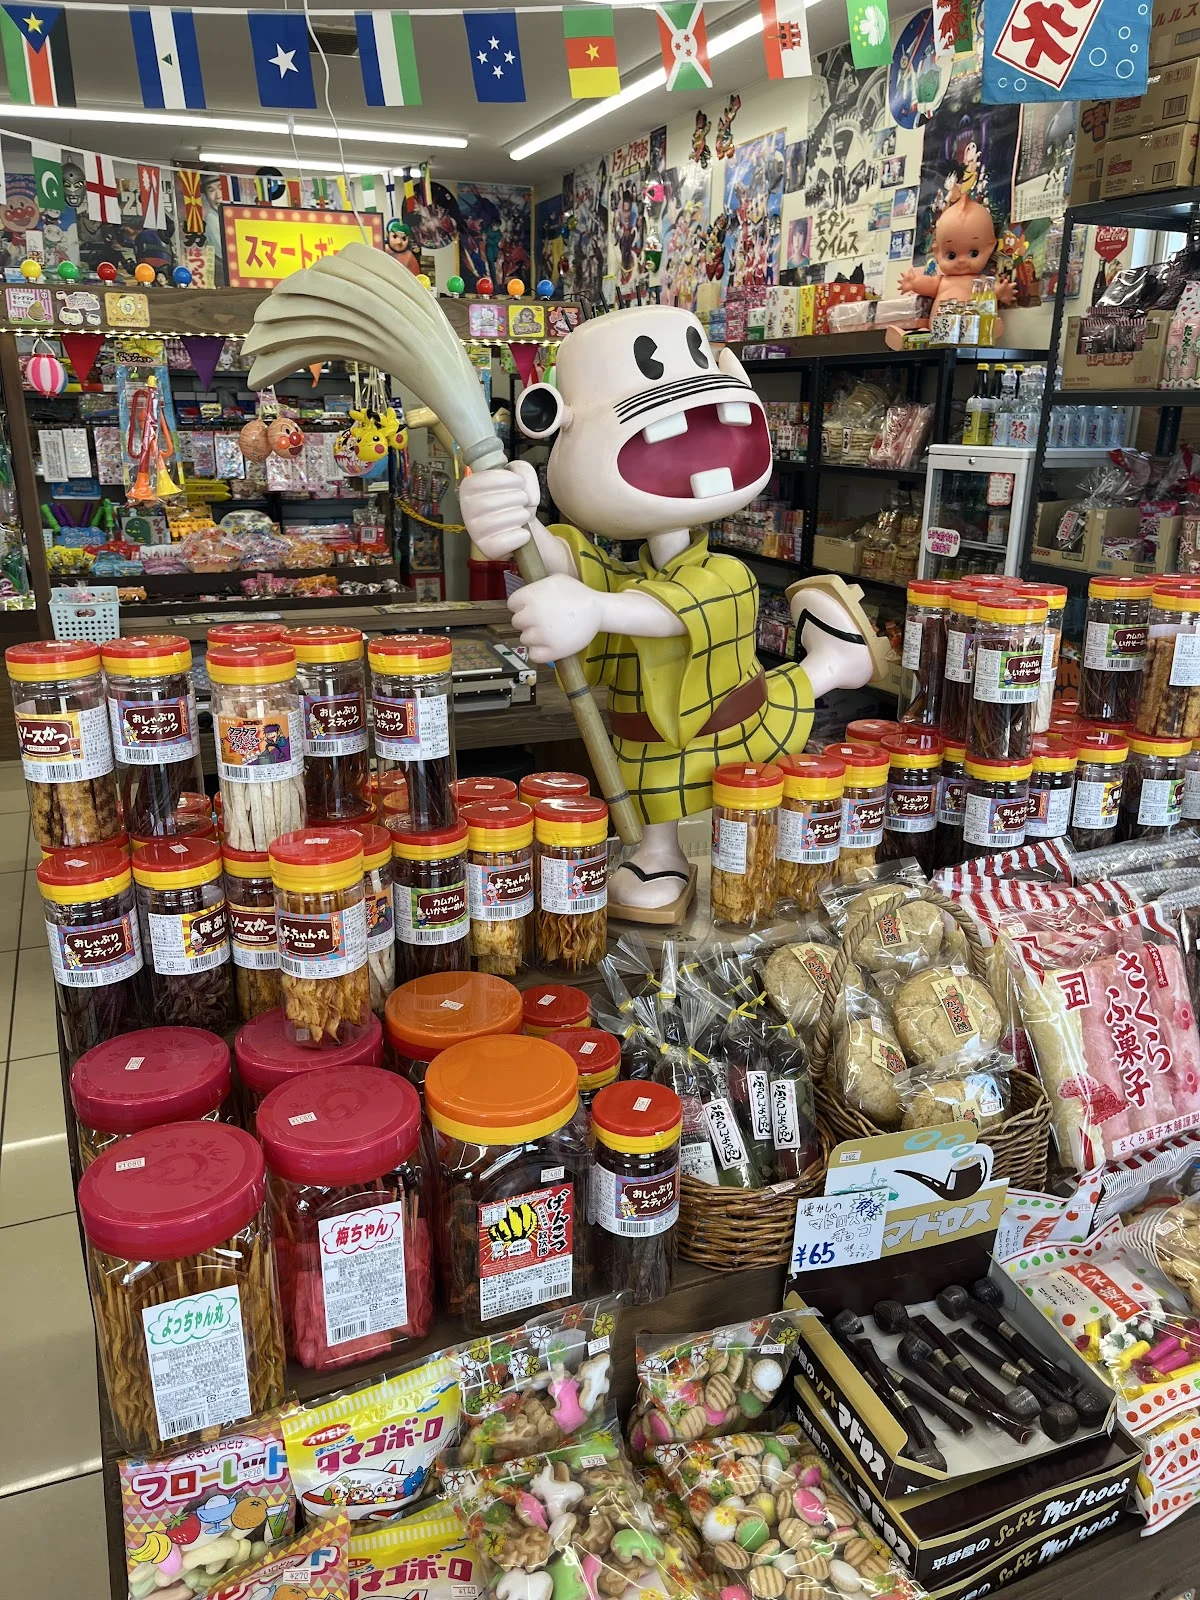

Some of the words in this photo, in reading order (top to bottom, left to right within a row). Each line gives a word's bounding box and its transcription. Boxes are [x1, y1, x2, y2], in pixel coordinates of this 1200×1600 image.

[244, 234, 340, 270] スマートボ
[132, 713, 176, 725] おしゃぶり
[320, 706, 357, 719] おしゃぶり
[328, 715, 359, 727] スティック
[141, 722, 179, 735] スティック
[377, 718, 404, 731] スティック
[897, 794, 928, 804] おしゃぶり
[902, 803, 929, 811] スティック
[426, 903, 465, 916] いかそーめん
[432, 896, 460, 907] カムカム
[74, 934, 119, 948] おしゃぶり
[283, 924, 330, 942] よっちゃん丸
[83, 942, 122, 958] スティック
[1116, 951, 1173, 1073] さくら
[1105, 986, 1152, 1107] ふ菓子
[633, 1182, 673, 1199] おしゃぶり
[640, 1191, 673, 1209] スティック
[546, 1189, 570, 1251] げんこつ
[883, 1199, 993, 1250] マドロス
[336, 1217, 390, 1248] 梅ちゃん
[794, 1241, 836, 1268] ¥65
[161, 1301, 226, 1339] よっちゃん丸
[309, 1424, 350, 1446] イワモト
[838, 1401, 887, 1482] マドロス
[186, 1439, 245, 1461] やさしい口どけ
[317, 1415, 446, 1476] タマゴボーロ
[243, 1467, 262, 1478] ¥270
[857, 1484, 912, 1566] マドロス
[931, 1537, 991, 1571] 平野屋の
[994, 1509, 1042, 1548] Soft
[1040, 1477, 1131, 1526] Matroos
[994, 1549, 1039, 1590] Soft
[1036, 1510, 1120, 1566] Matroos
[289, 1571, 309, 1581] ¥270
[457, 1586, 477, 1597] ¥140
